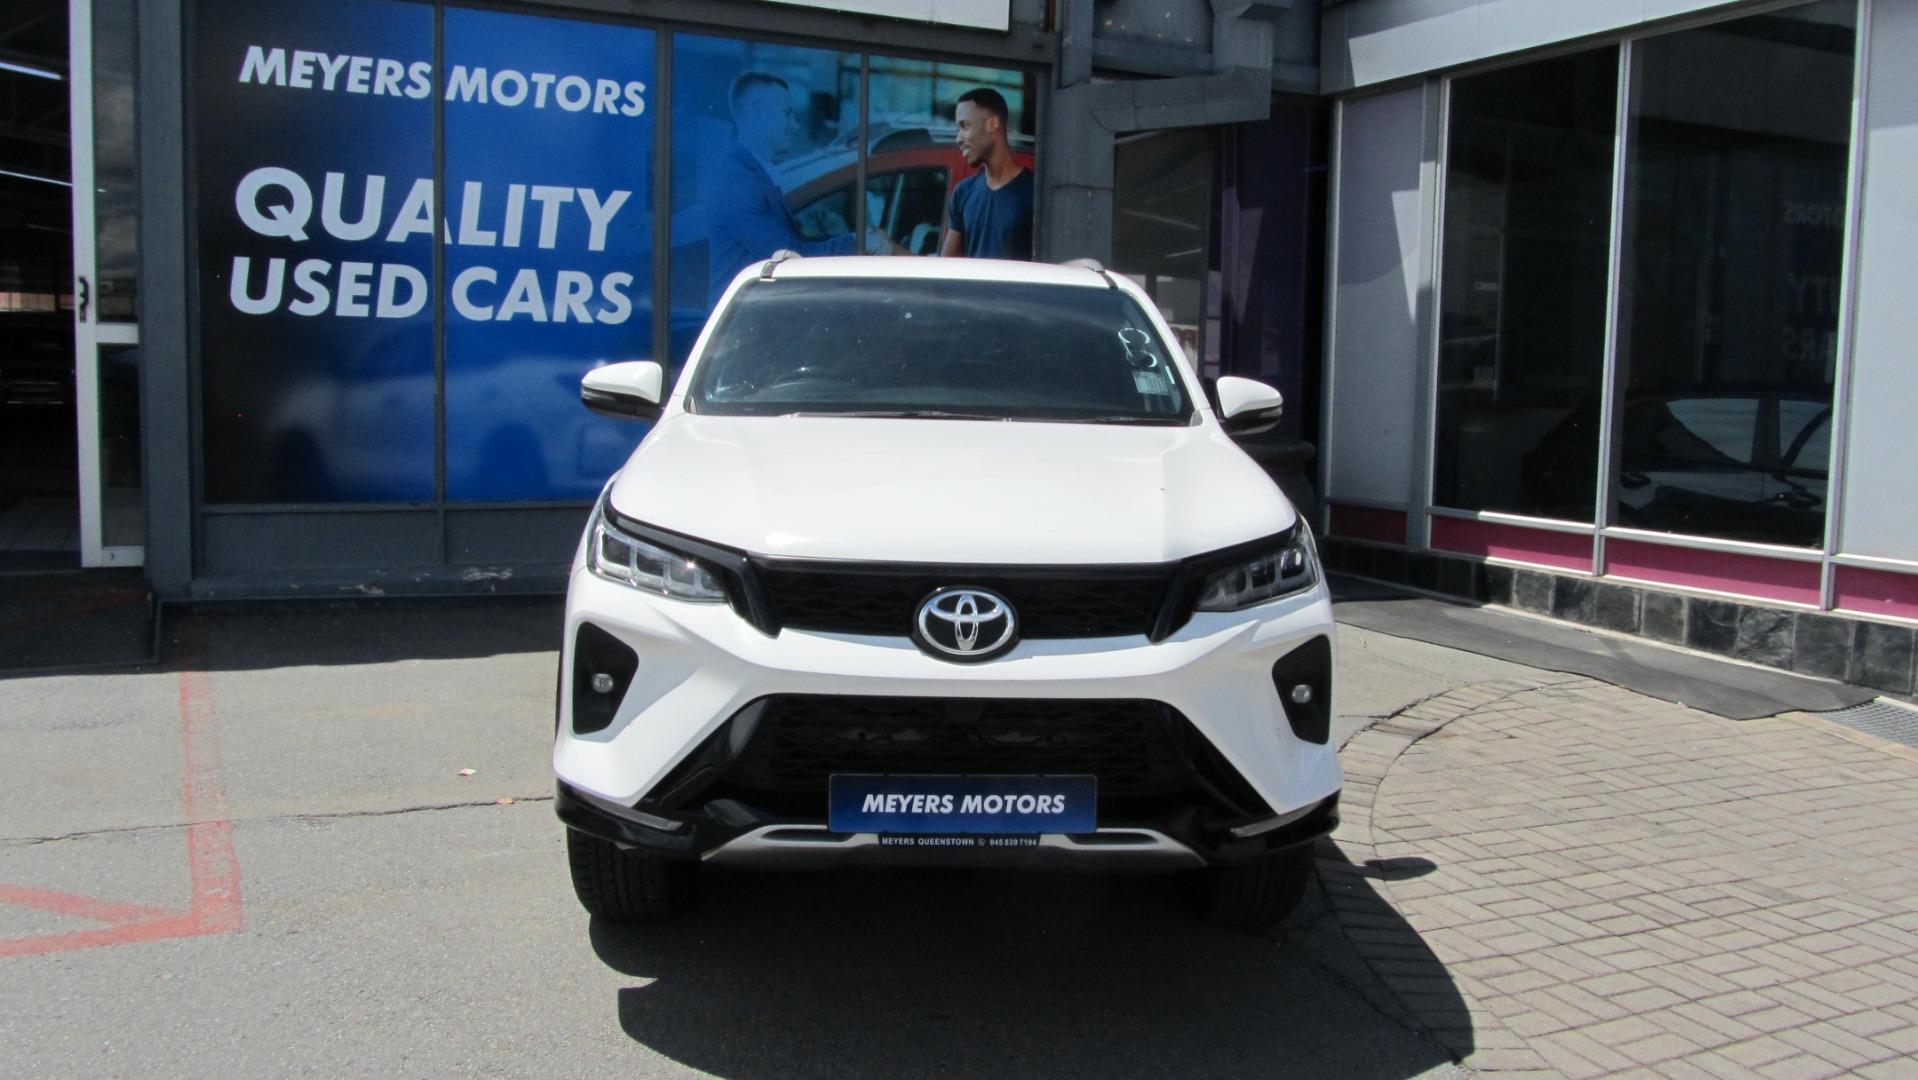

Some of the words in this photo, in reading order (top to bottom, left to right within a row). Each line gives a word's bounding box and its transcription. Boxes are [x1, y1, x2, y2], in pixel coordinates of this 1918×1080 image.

[238, 45, 432, 100] MEYERS
[445, 65, 646, 117] MOTORS
[235, 166, 632, 251] QUALITY
[229, 256, 428, 319] USED
[451, 266, 635, 325] CARS
[861, 794, 954, 813] MEYERS
[960, 794, 1065, 814] MOTORS
[882, 837, 915, 846] MEYERS
[917, 837, 975, 846] QUEENSTOWN
[989, 838, 1004, 847] 045
